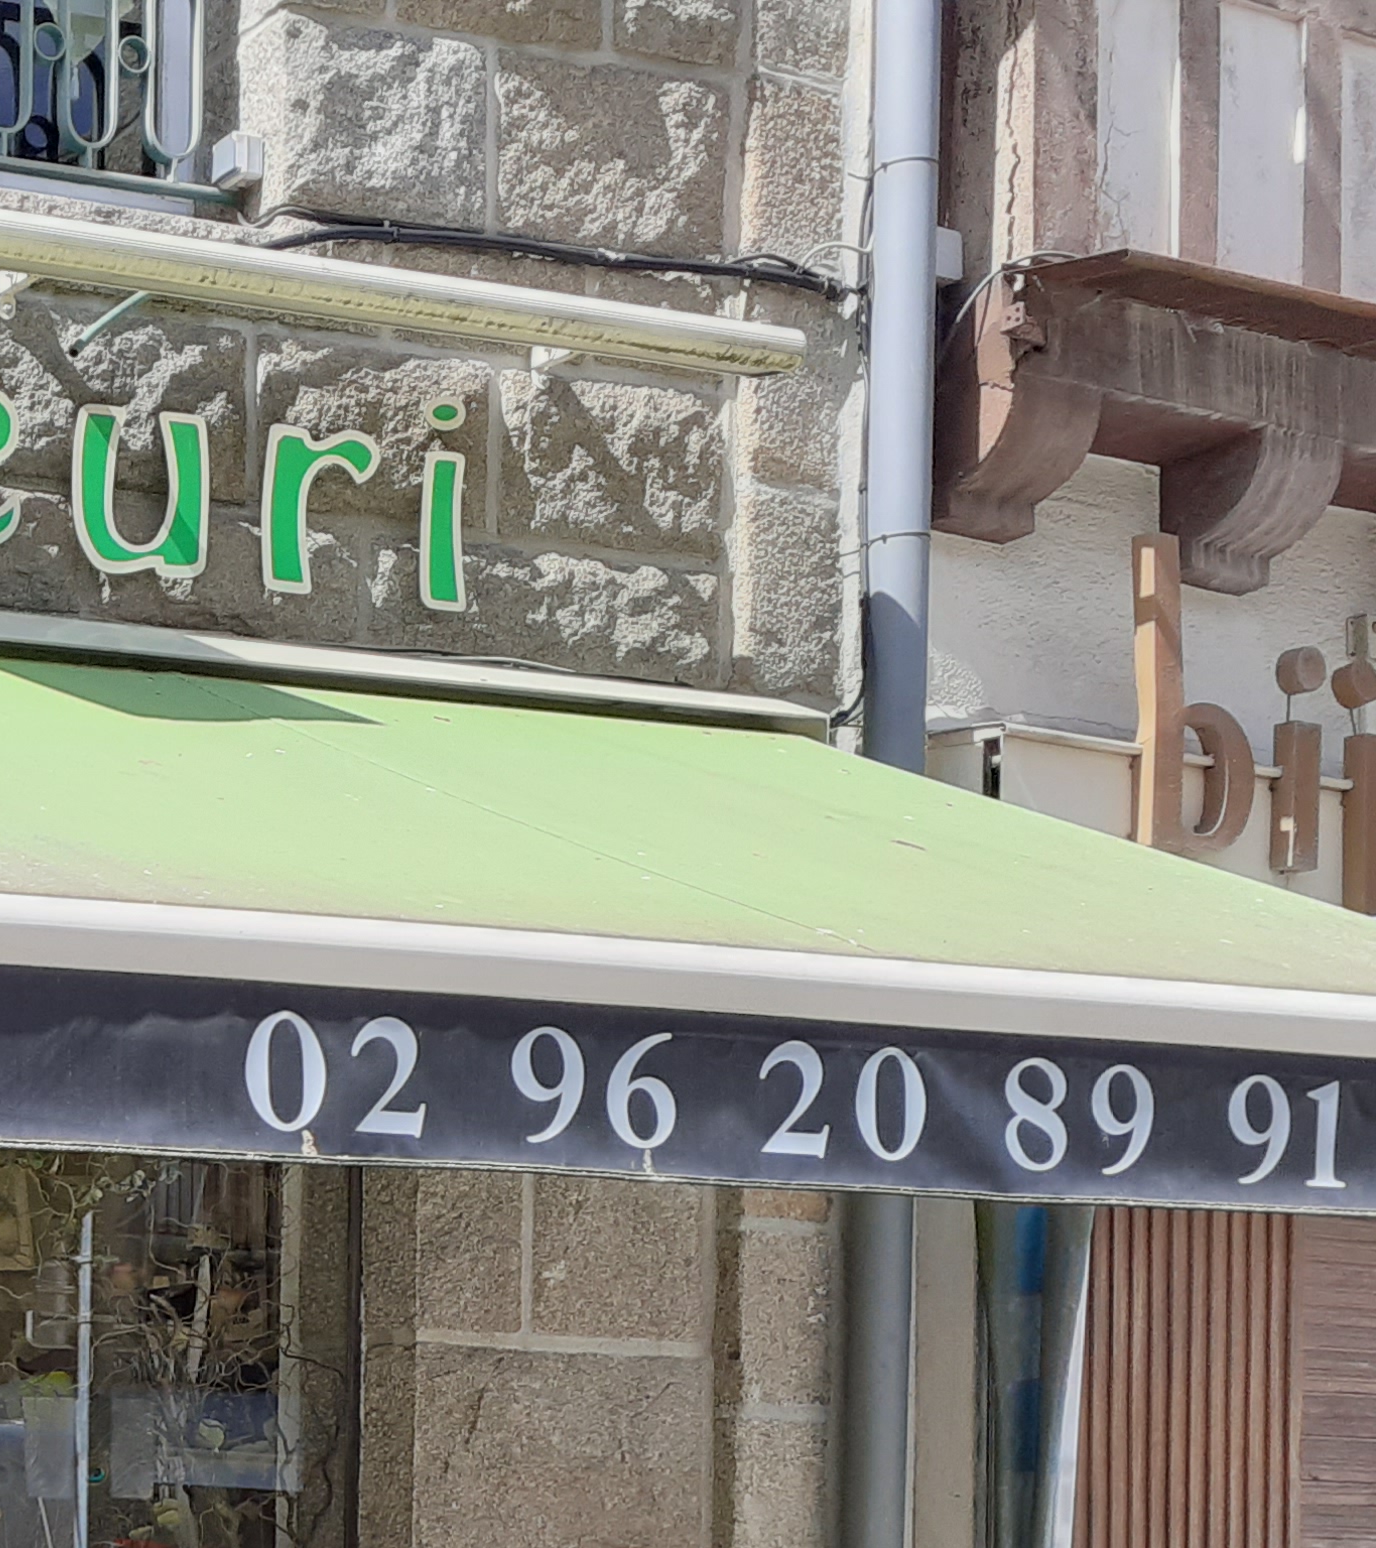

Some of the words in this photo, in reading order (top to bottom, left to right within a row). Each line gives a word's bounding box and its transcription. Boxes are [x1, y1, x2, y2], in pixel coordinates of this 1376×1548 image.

[244, 1009, 428, 1139] 02
[510, 1025, 678, 1151] 96
[758, 1039, 927, 1162] 20
[1004, 1056, 1155, 1176] 89
[1227, 1073, 1347, 1189] 91
